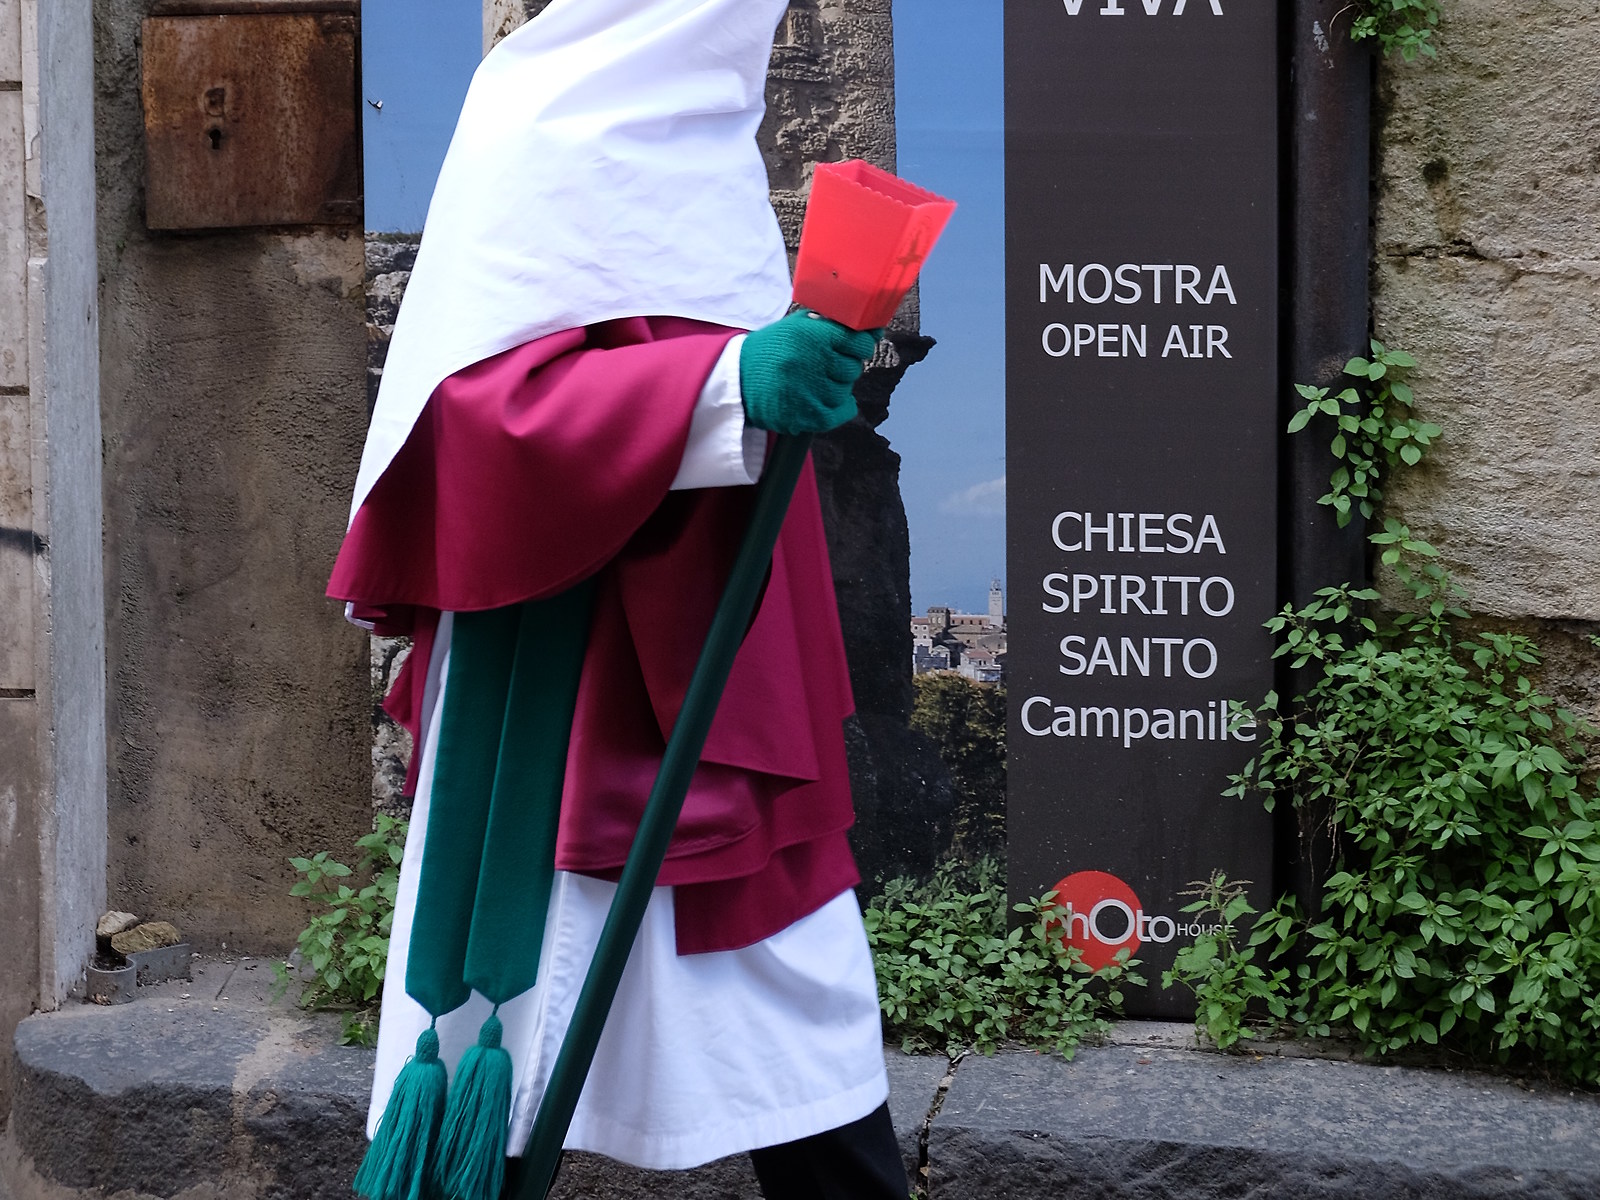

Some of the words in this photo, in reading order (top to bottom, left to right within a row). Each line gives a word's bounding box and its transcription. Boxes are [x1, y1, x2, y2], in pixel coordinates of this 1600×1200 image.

[1039, 263, 1237, 305] MOSTRA
[1041, 322, 1147, 358] OPEN
[1161, 324, 1233, 359] AIR
[1051, 511, 1227, 554] CHIESA
[1042, 573, 1235, 617] SPIRITO
[1059, 635, 1218, 679] SANTO
[1020, 696, 1257, 749] Campanile
